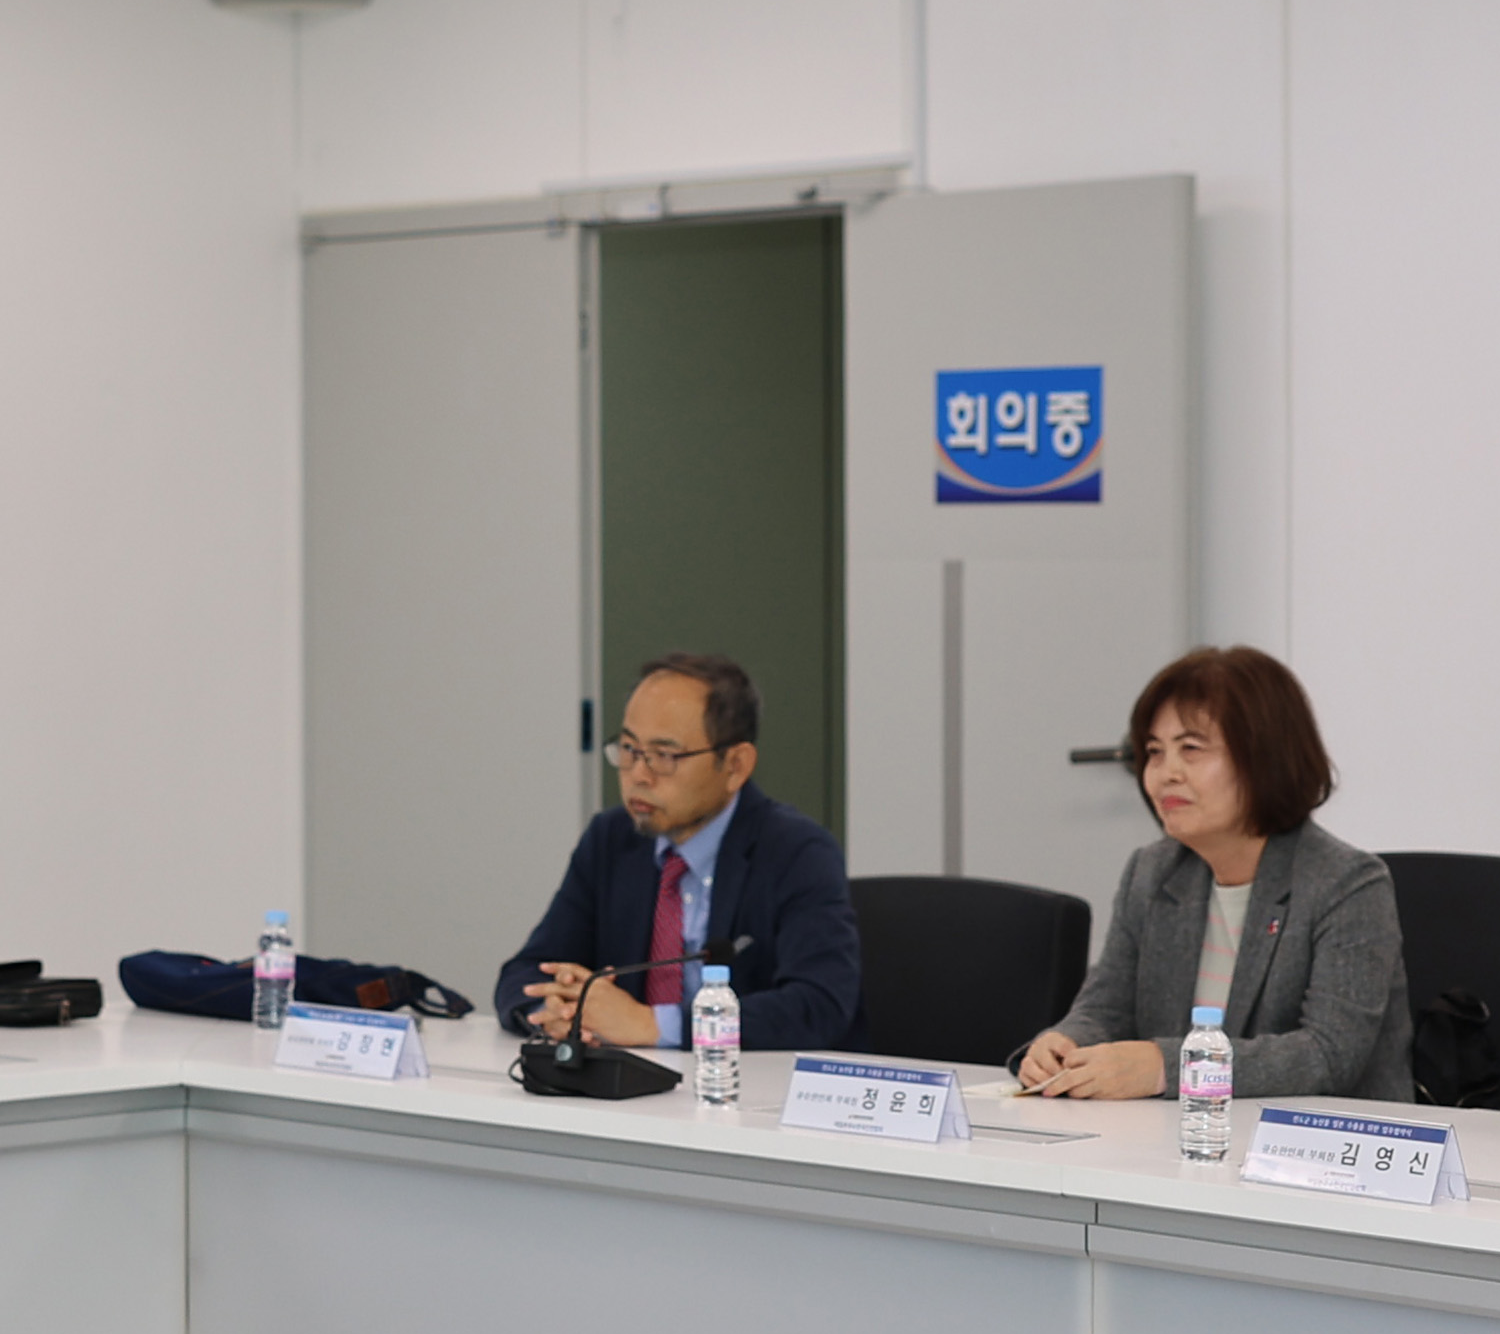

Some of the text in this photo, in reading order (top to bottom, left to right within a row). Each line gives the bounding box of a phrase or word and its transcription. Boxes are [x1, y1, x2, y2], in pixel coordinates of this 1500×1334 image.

[946, 391, 1091, 458] 회의중
[862, 1088, 935, 1116] 정윤희
[1340, 1142, 1429, 1176] 김영신
